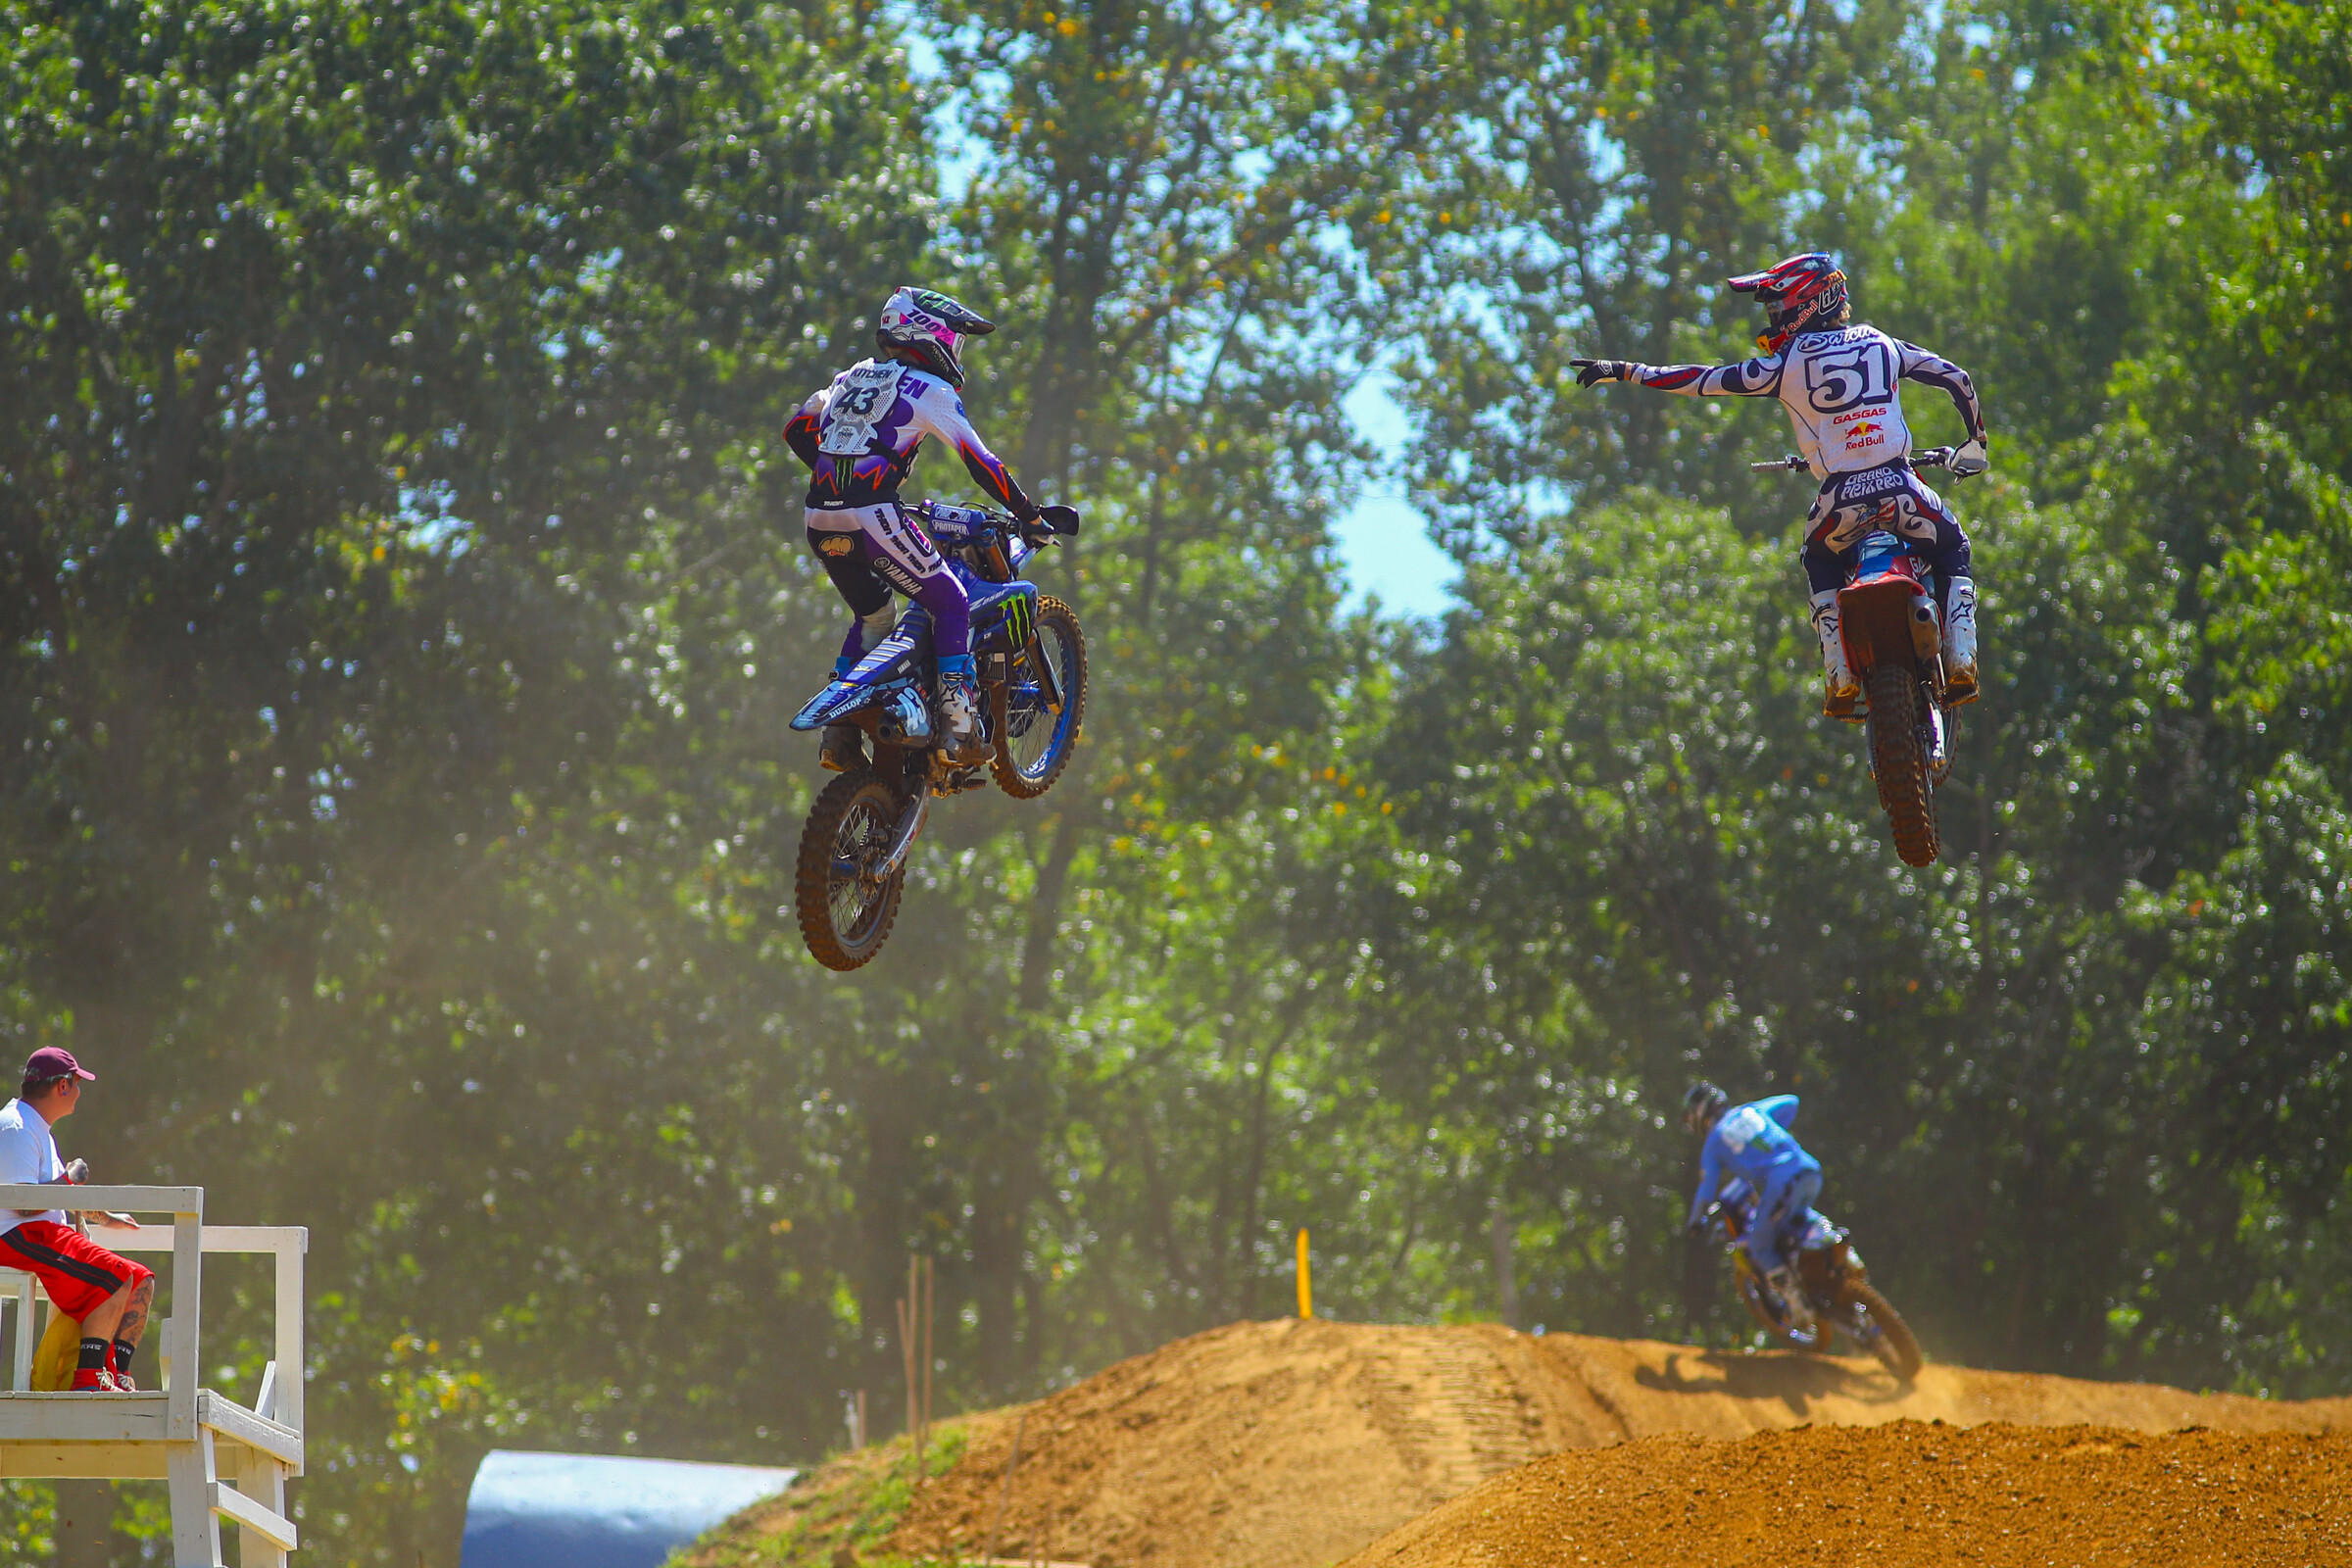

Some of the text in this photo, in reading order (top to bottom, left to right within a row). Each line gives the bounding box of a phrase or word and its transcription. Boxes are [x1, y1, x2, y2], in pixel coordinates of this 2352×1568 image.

[906, 309, 954, 342] 100%
[1788, 299, 1819, 332] Red Bull
[850, 368, 894, 379] KITCHEN
[1646, 368, 1699, 388] GASGAS
[1804, 341, 1892, 414] 51
[833, 387, 880, 415] 43
[1833, 407, 1887, 424] GASGAS
[1845, 434, 1885, 451] Red Bull
[1844, 466, 1894, 486] GRAND
[1875, 473, 1904, 491] PRO
[935, 507, 971, 522] PROPER
[935, 521, 967, 535] PROTAPER
[883, 564, 923, 595] YAMAHA
[828, 698, 862, 718] DUNLOP
